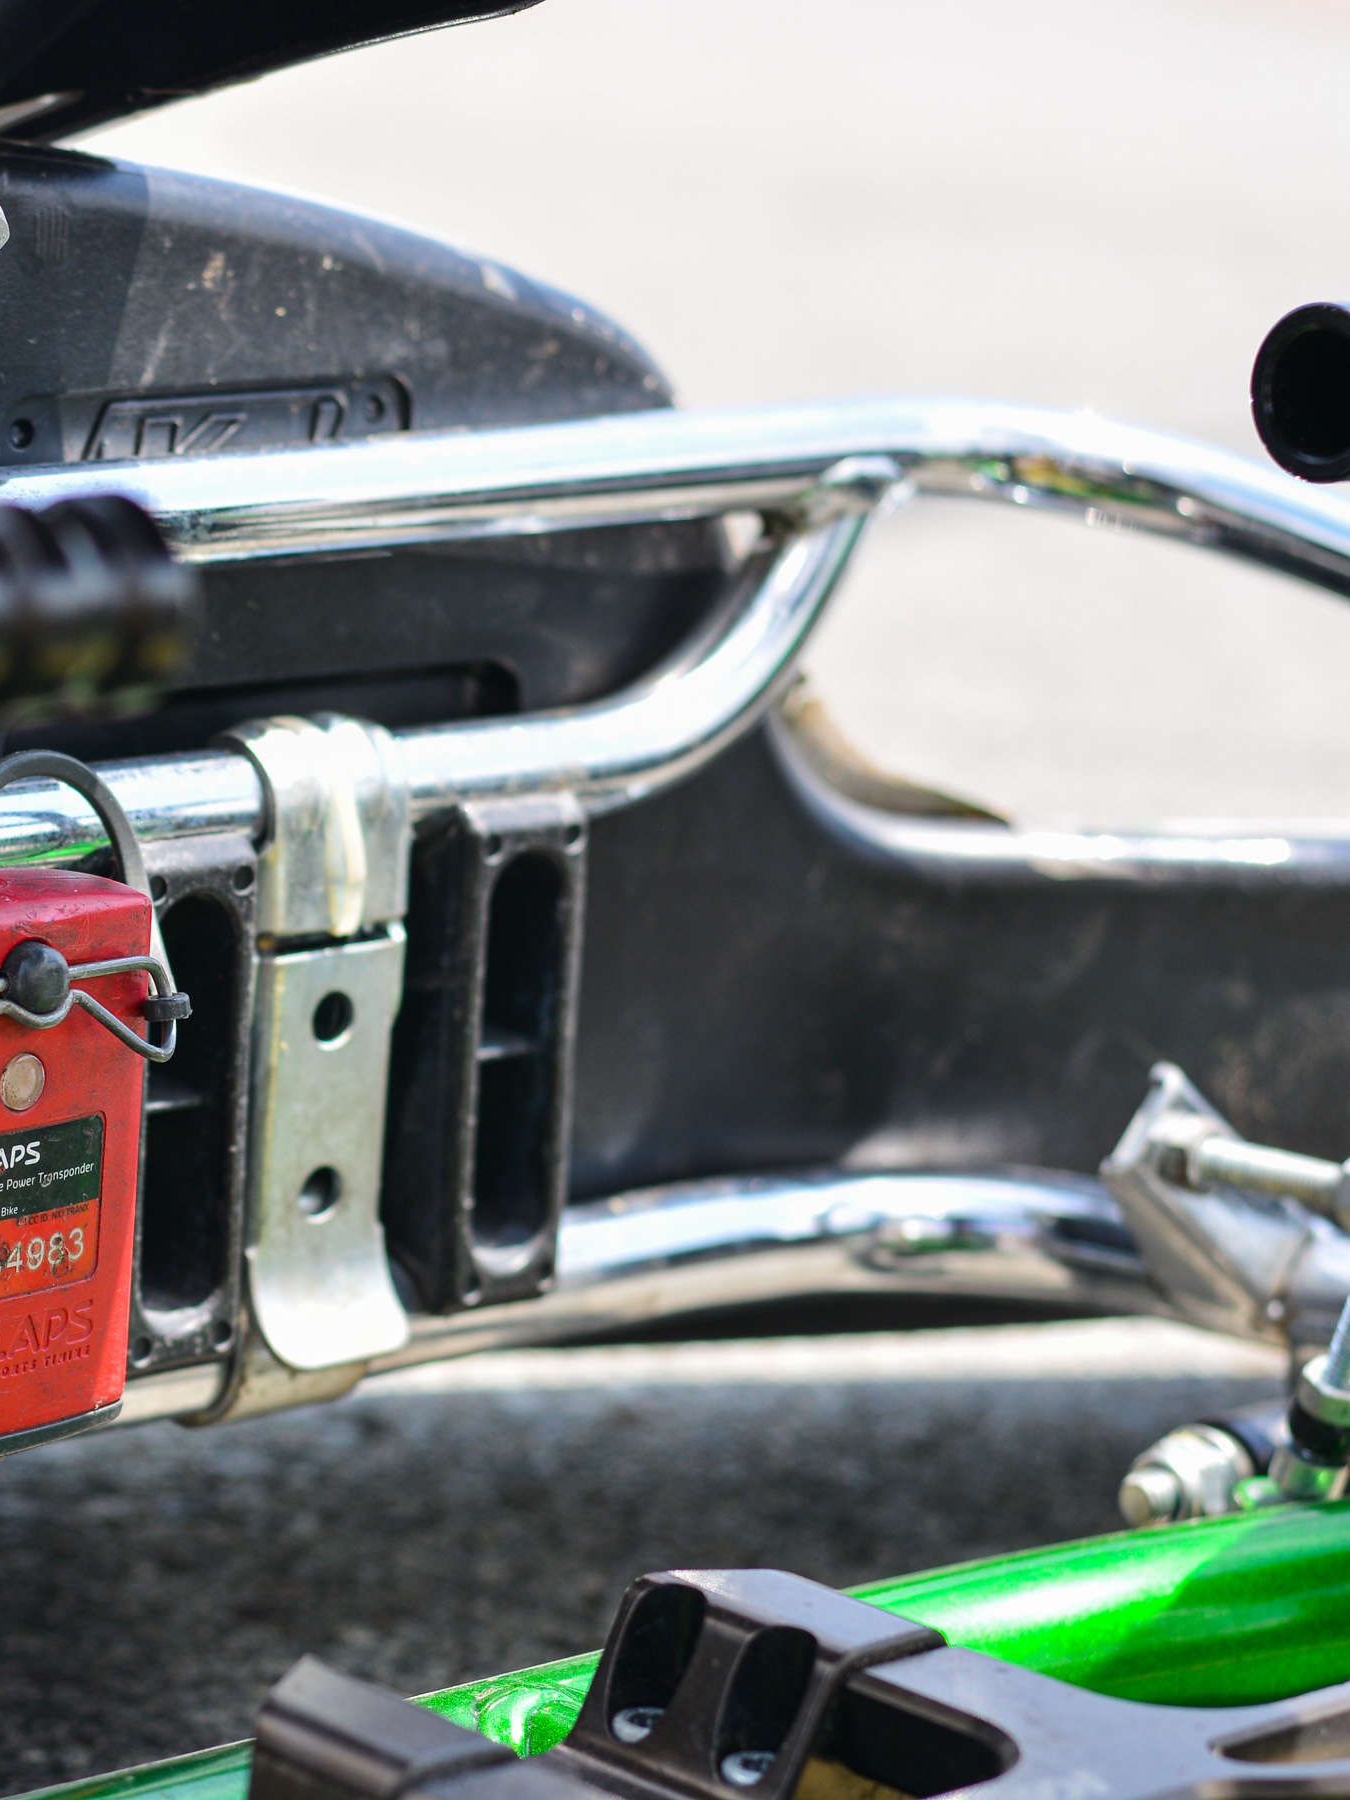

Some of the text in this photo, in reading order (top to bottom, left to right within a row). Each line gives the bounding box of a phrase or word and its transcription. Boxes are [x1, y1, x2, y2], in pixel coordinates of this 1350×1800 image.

[6, 1175, 36, 1191] Power
[38, 1163, 94, 1184] Transponder
[1, 1205, 18, 1216] Bike
